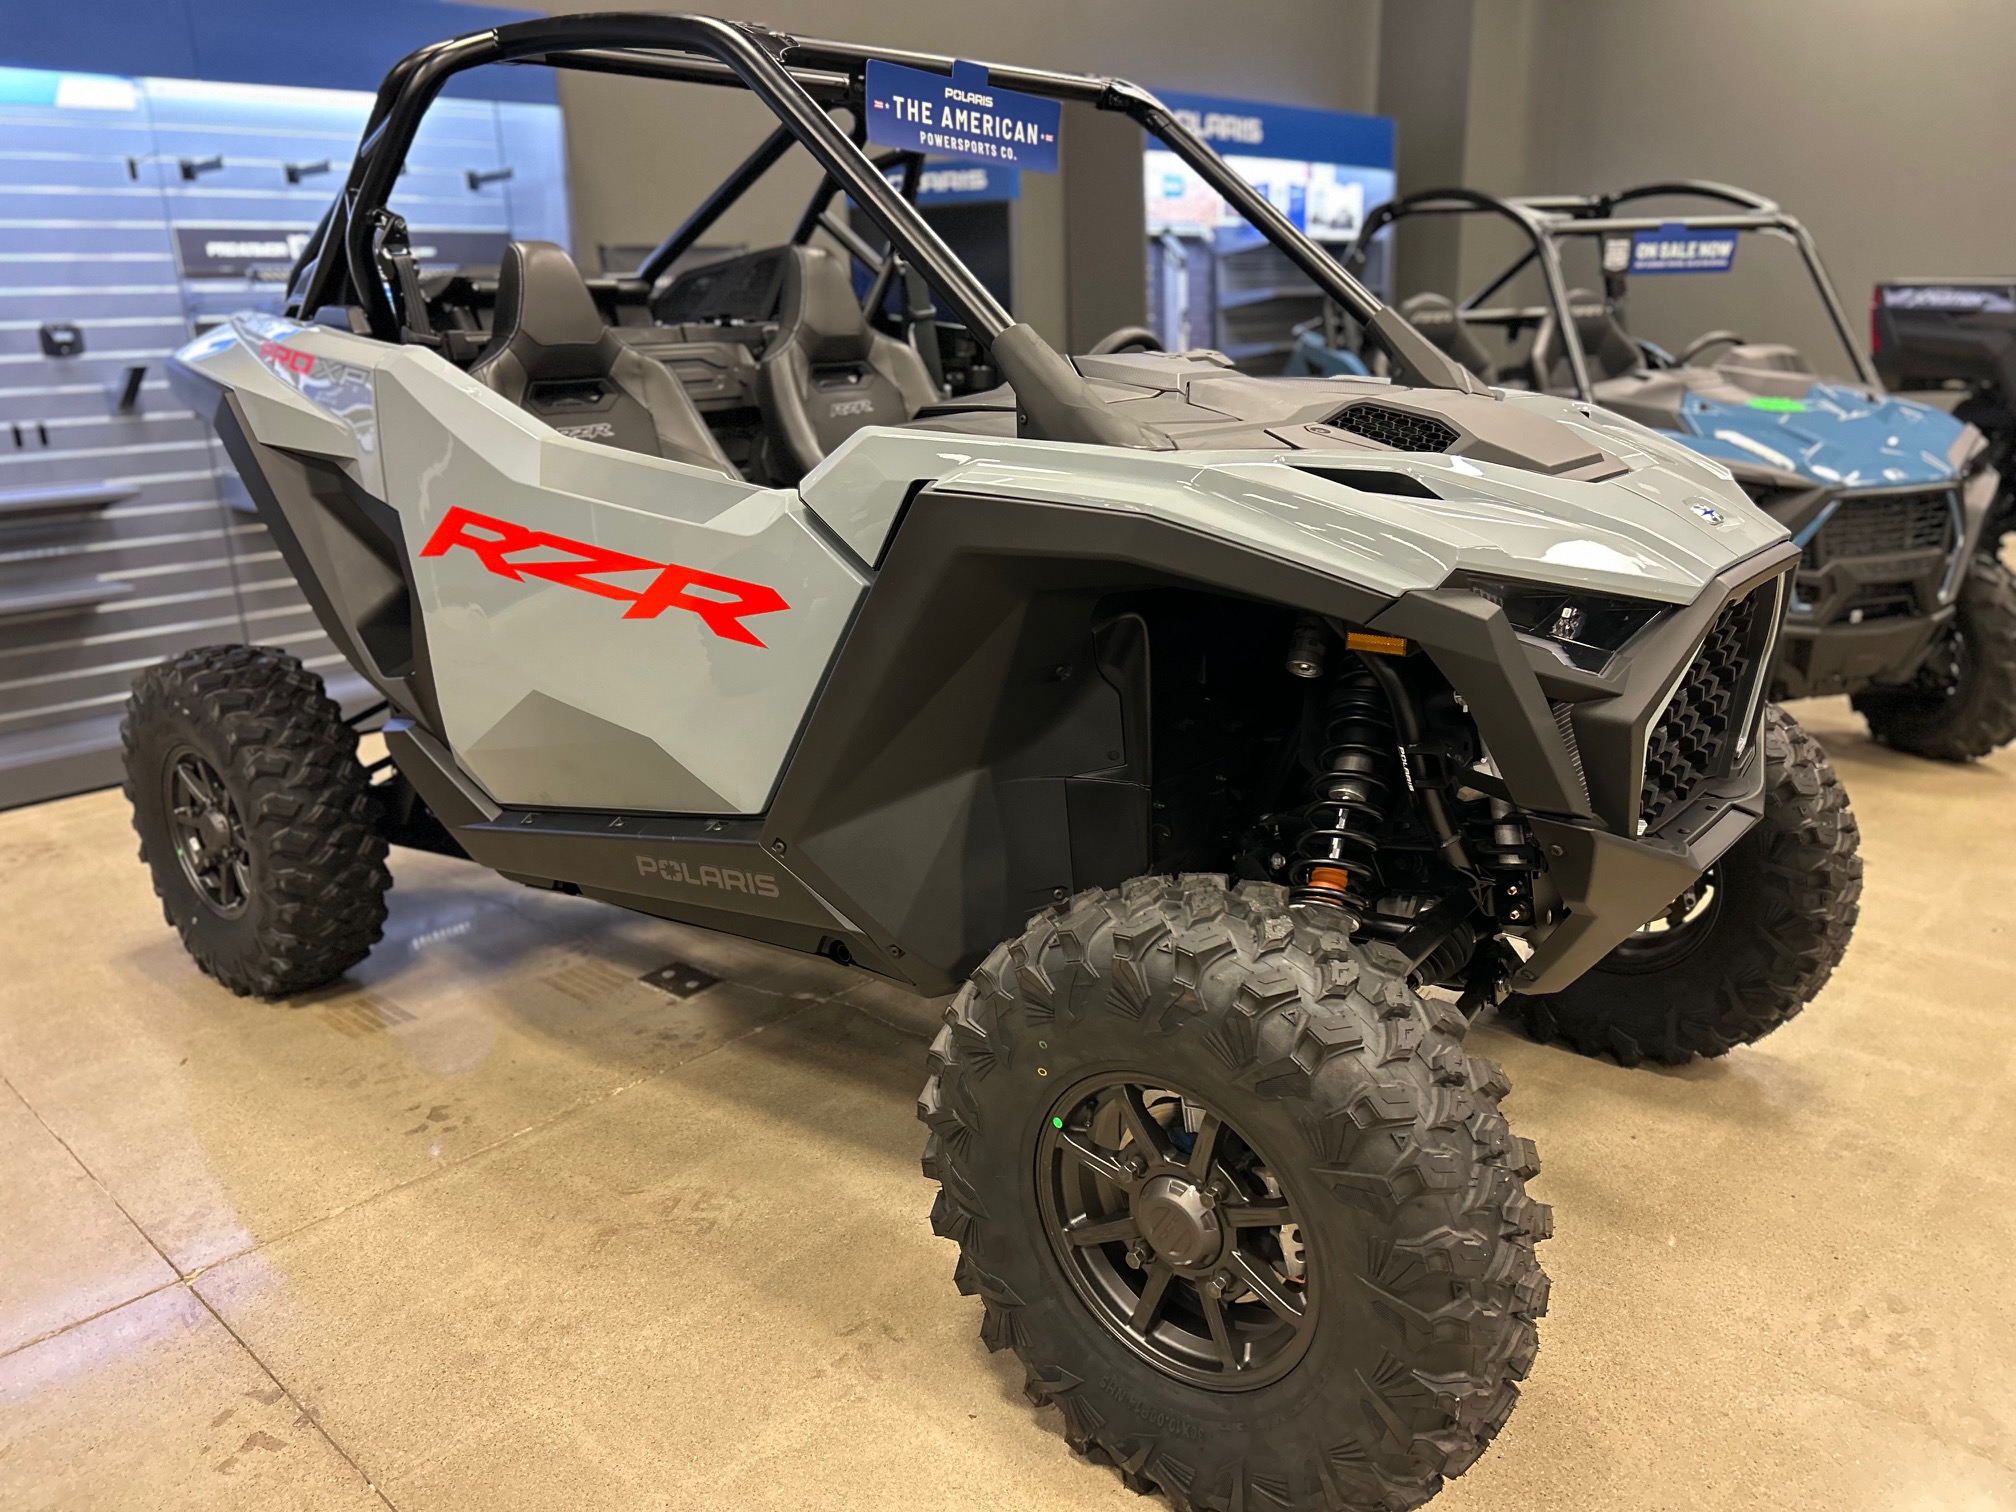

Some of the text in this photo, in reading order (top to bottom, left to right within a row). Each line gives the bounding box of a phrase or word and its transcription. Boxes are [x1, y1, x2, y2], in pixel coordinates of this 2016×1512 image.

[944, 87, 994, 108] POLARIS
[892, 95, 1039, 145] THE AMERICAN
[1172, 108, 1264, 145] OLARIS
[919, 130, 1018, 161] POWERSPORTS CO.
[1635, 242, 1658, 259] ON
[1660, 240, 1697, 259] SALE
[1699, 239, 1734, 257] NOW
[419, 505, 792, 650] RZR
[1398, 746, 1415, 792] POLARIS
[635, 855, 780, 898] POLARIS
